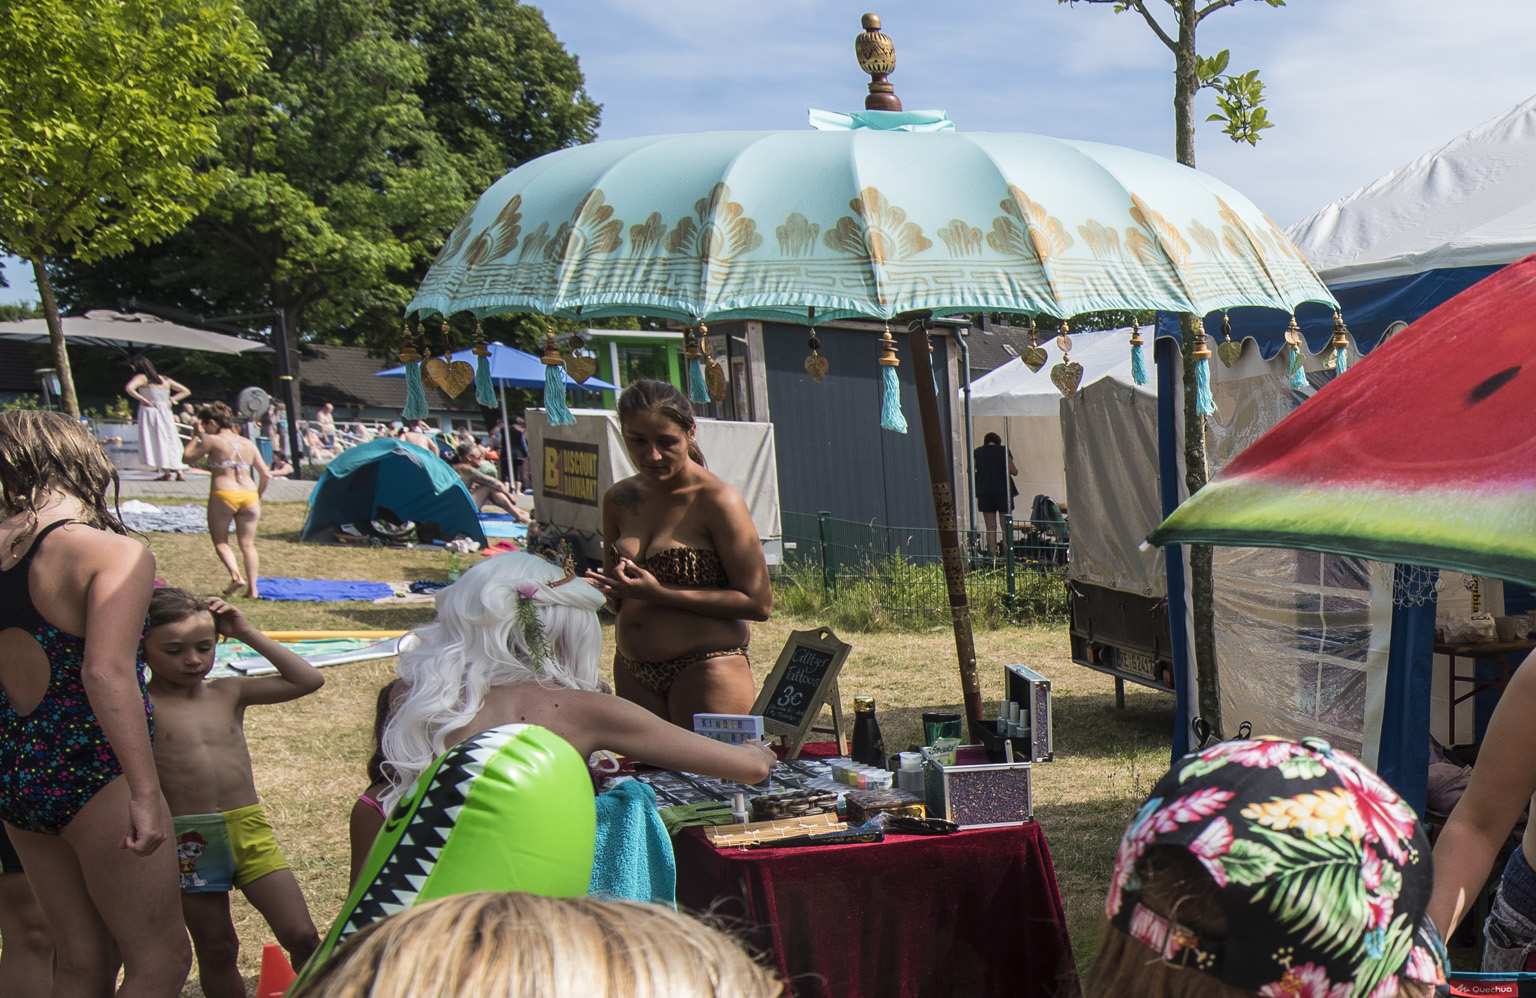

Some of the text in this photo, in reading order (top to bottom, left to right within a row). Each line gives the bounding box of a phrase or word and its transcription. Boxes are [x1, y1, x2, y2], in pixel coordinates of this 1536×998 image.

[563, 449, 597, 477] DISCOUNT
[786, 666, 820, 687] Tattoos
[777, 685, 803, 706] 3€
[701, 719, 743, 729] KINDER
[1472, 985, 1513, 993] Quechua
